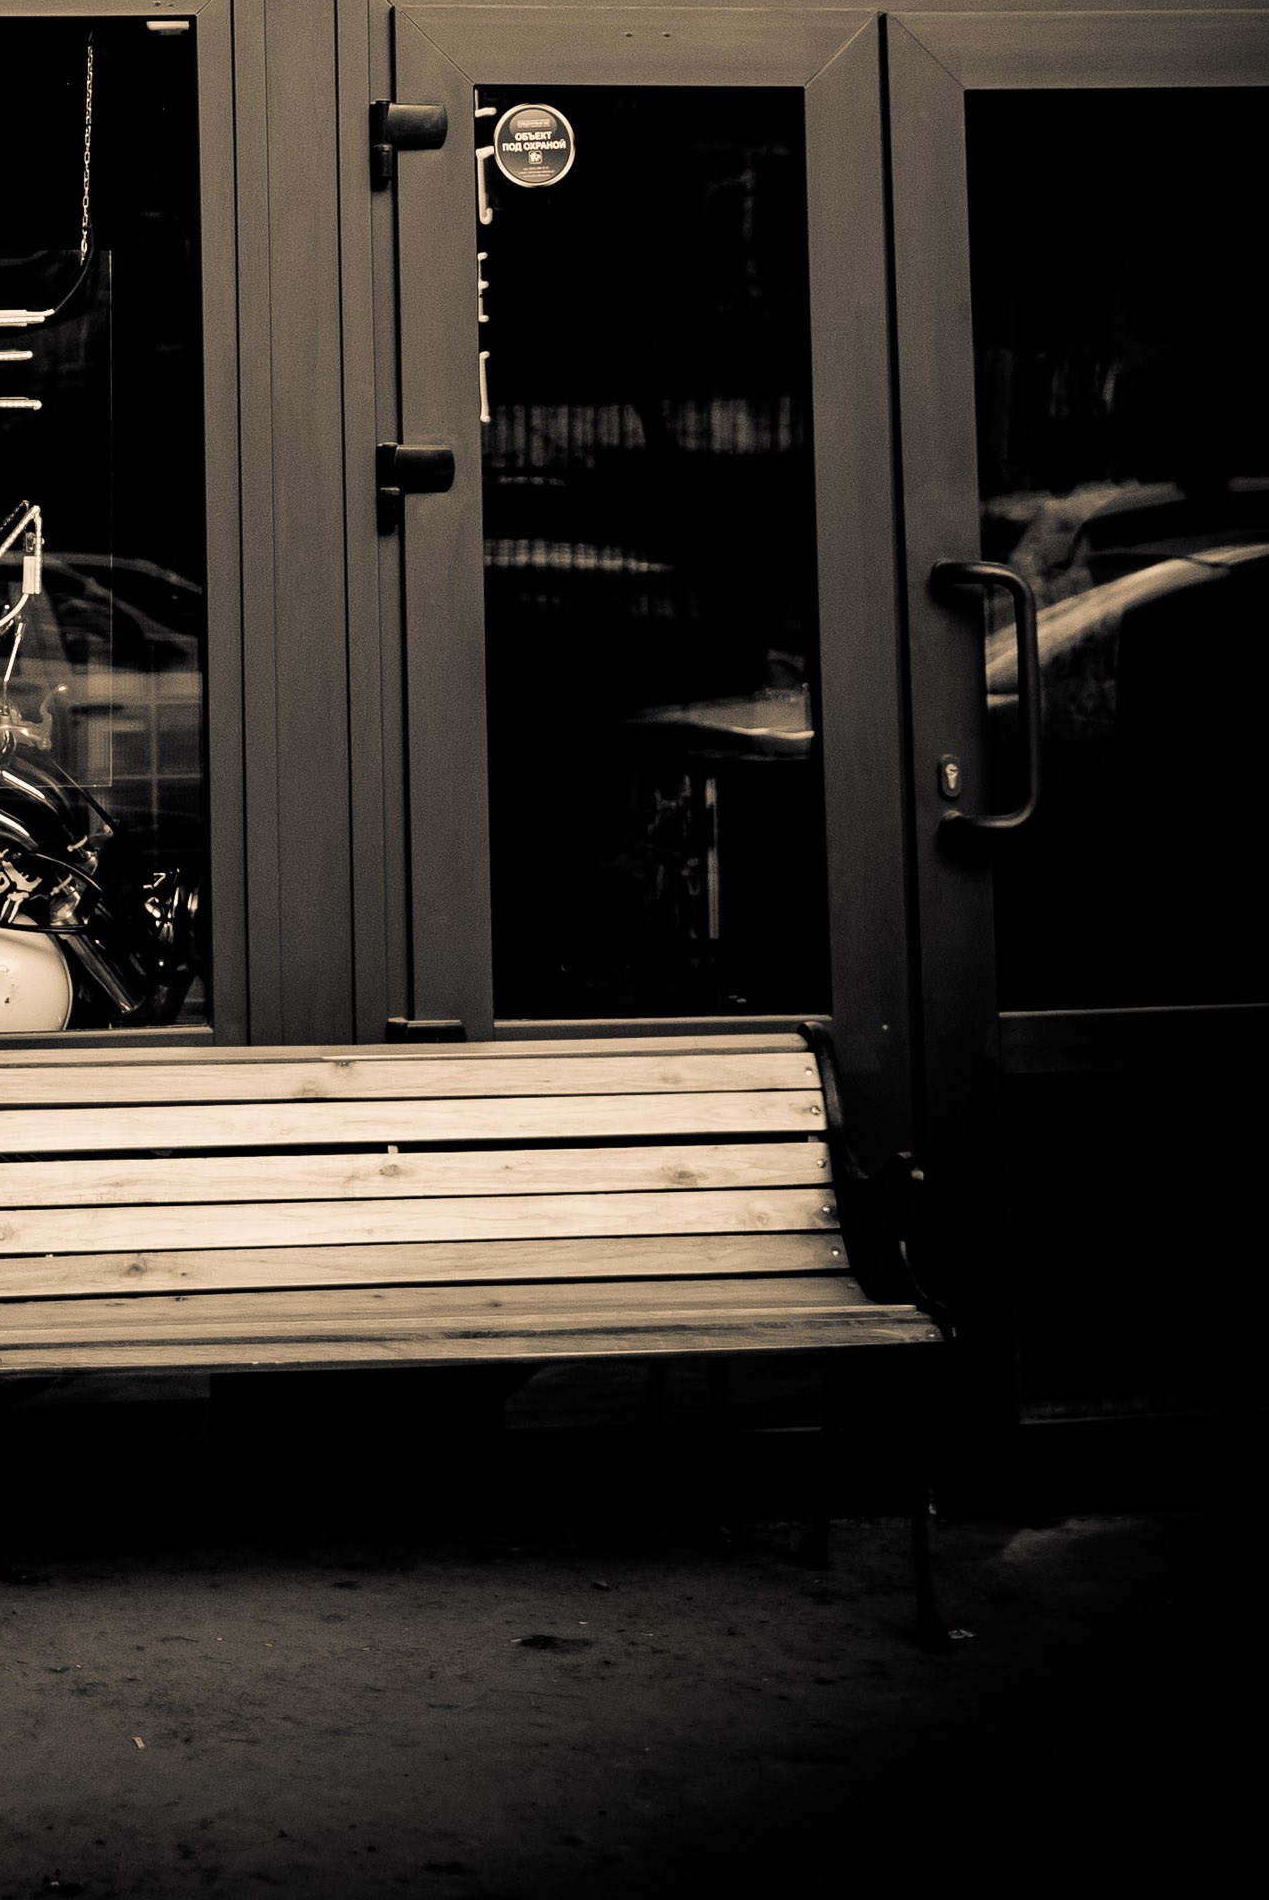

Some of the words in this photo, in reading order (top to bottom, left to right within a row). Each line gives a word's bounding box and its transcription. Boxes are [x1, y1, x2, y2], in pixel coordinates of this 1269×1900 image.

[514, 131, 552, 141] ОБЪЕКТ
[502, 142, 522, 152] ПОД
[523, 138, 567, 151] ОХРАНОЙ
